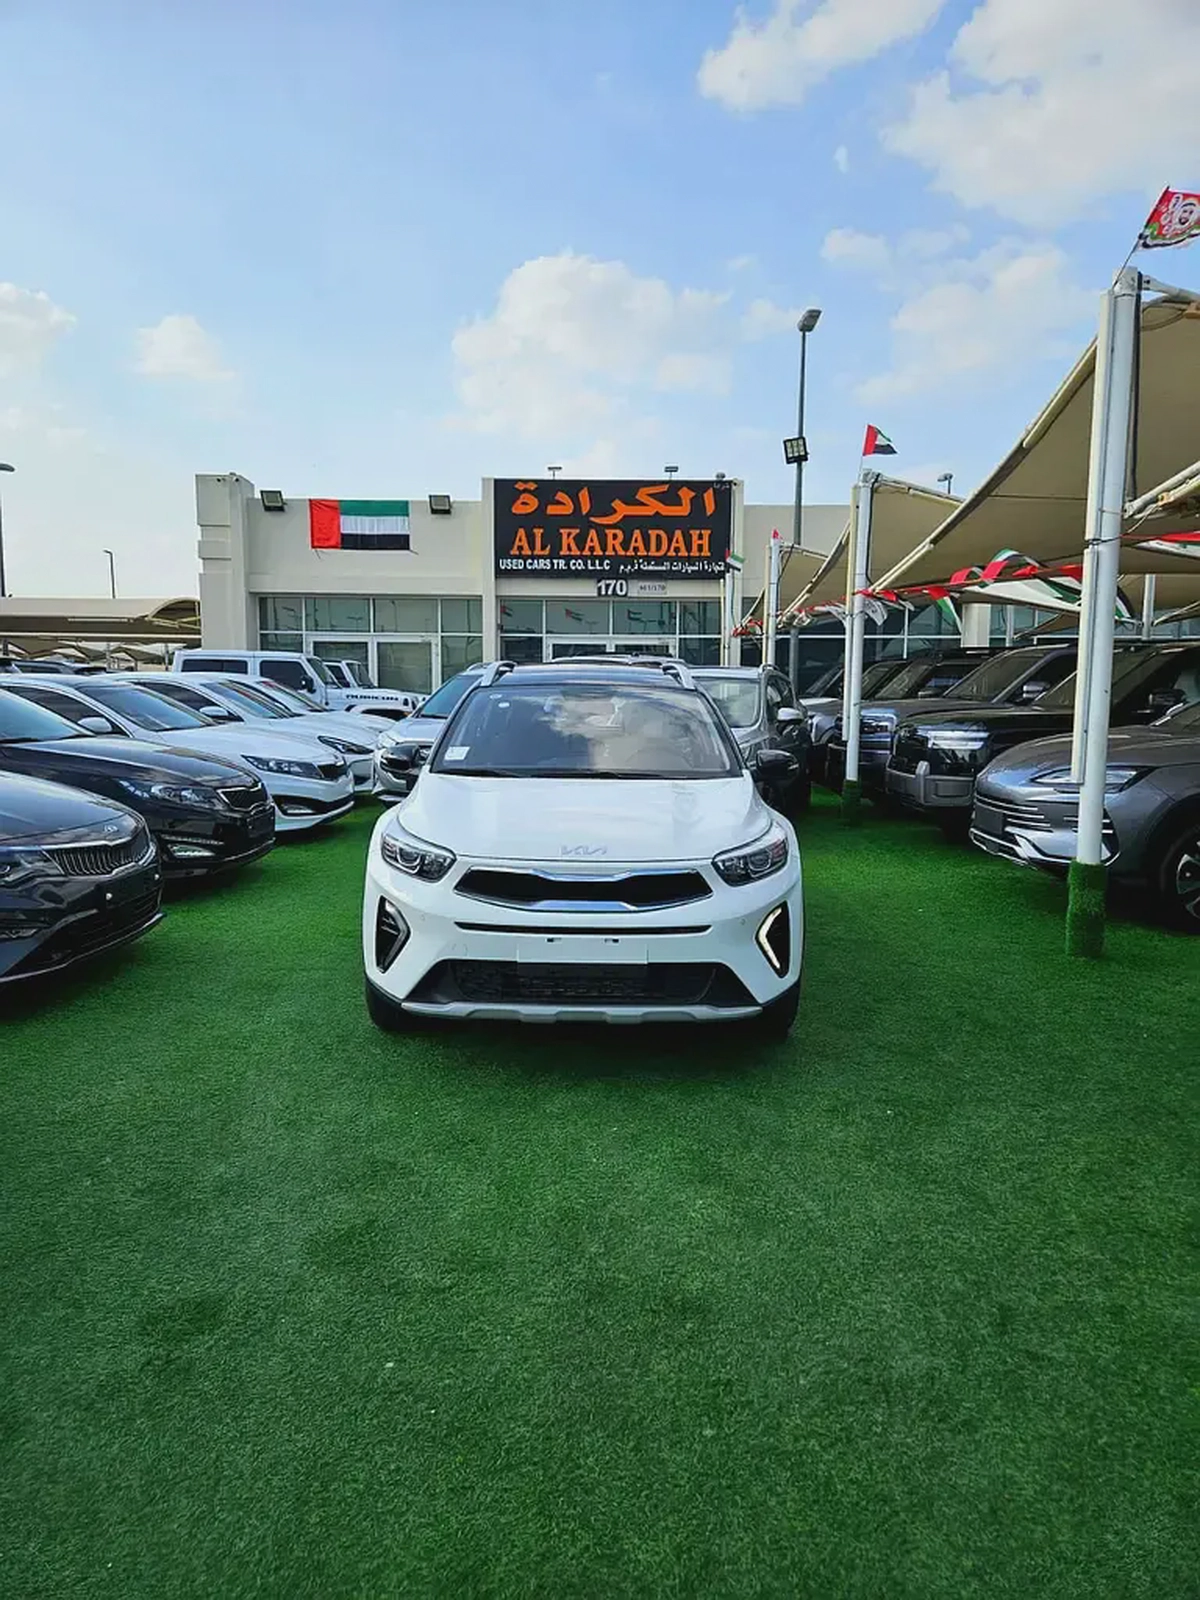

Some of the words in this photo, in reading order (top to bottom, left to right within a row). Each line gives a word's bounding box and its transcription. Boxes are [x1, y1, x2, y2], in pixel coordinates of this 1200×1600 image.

[511, 481, 716, 525] الكرادة
[510, 528, 550, 556] AL
[559, 528, 712, 557] KARADAH
[499, 558, 524, 570] USED
[525, 558, 551, 570] CARS
[552, 558, 568, 570] TR.
[570, 559, 585, 570] CO.
[672, 559, 702, 573] السيارات
[704, 560, 725, 573] تجارة
[598, 579, 627, 596] 170
